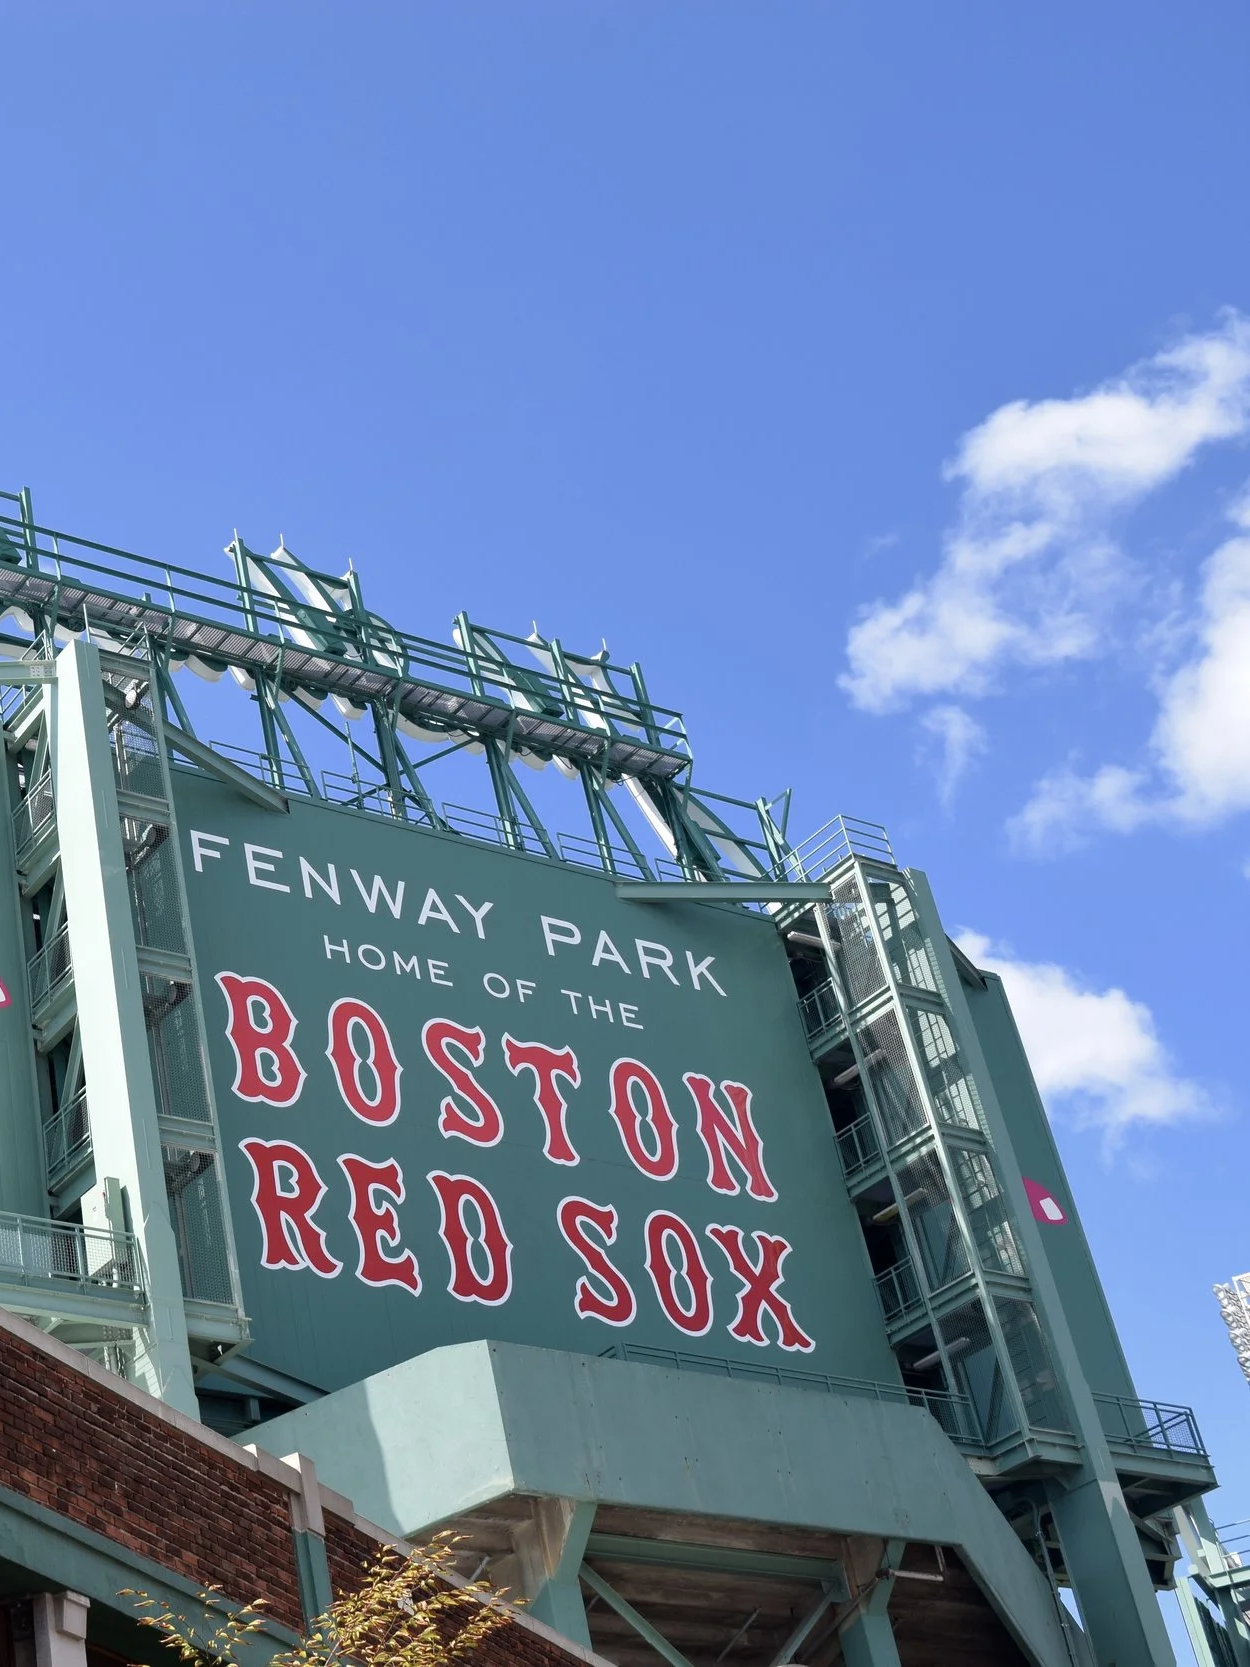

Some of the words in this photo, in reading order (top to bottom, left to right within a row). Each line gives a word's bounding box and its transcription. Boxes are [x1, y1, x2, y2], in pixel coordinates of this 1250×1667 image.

[190, 829, 494, 940] FENWAY
[540, 914, 728, 998] PARK
[323, 934, 454, 987] HOME
[483, 972, 537, 1004] OF
[560, 988, 645, 1030] THE
[214, 970, 779, 1203] BOSTON
[237, 1136, 514, 1307] RED
[556, 1195, 817, 1354] SOX
